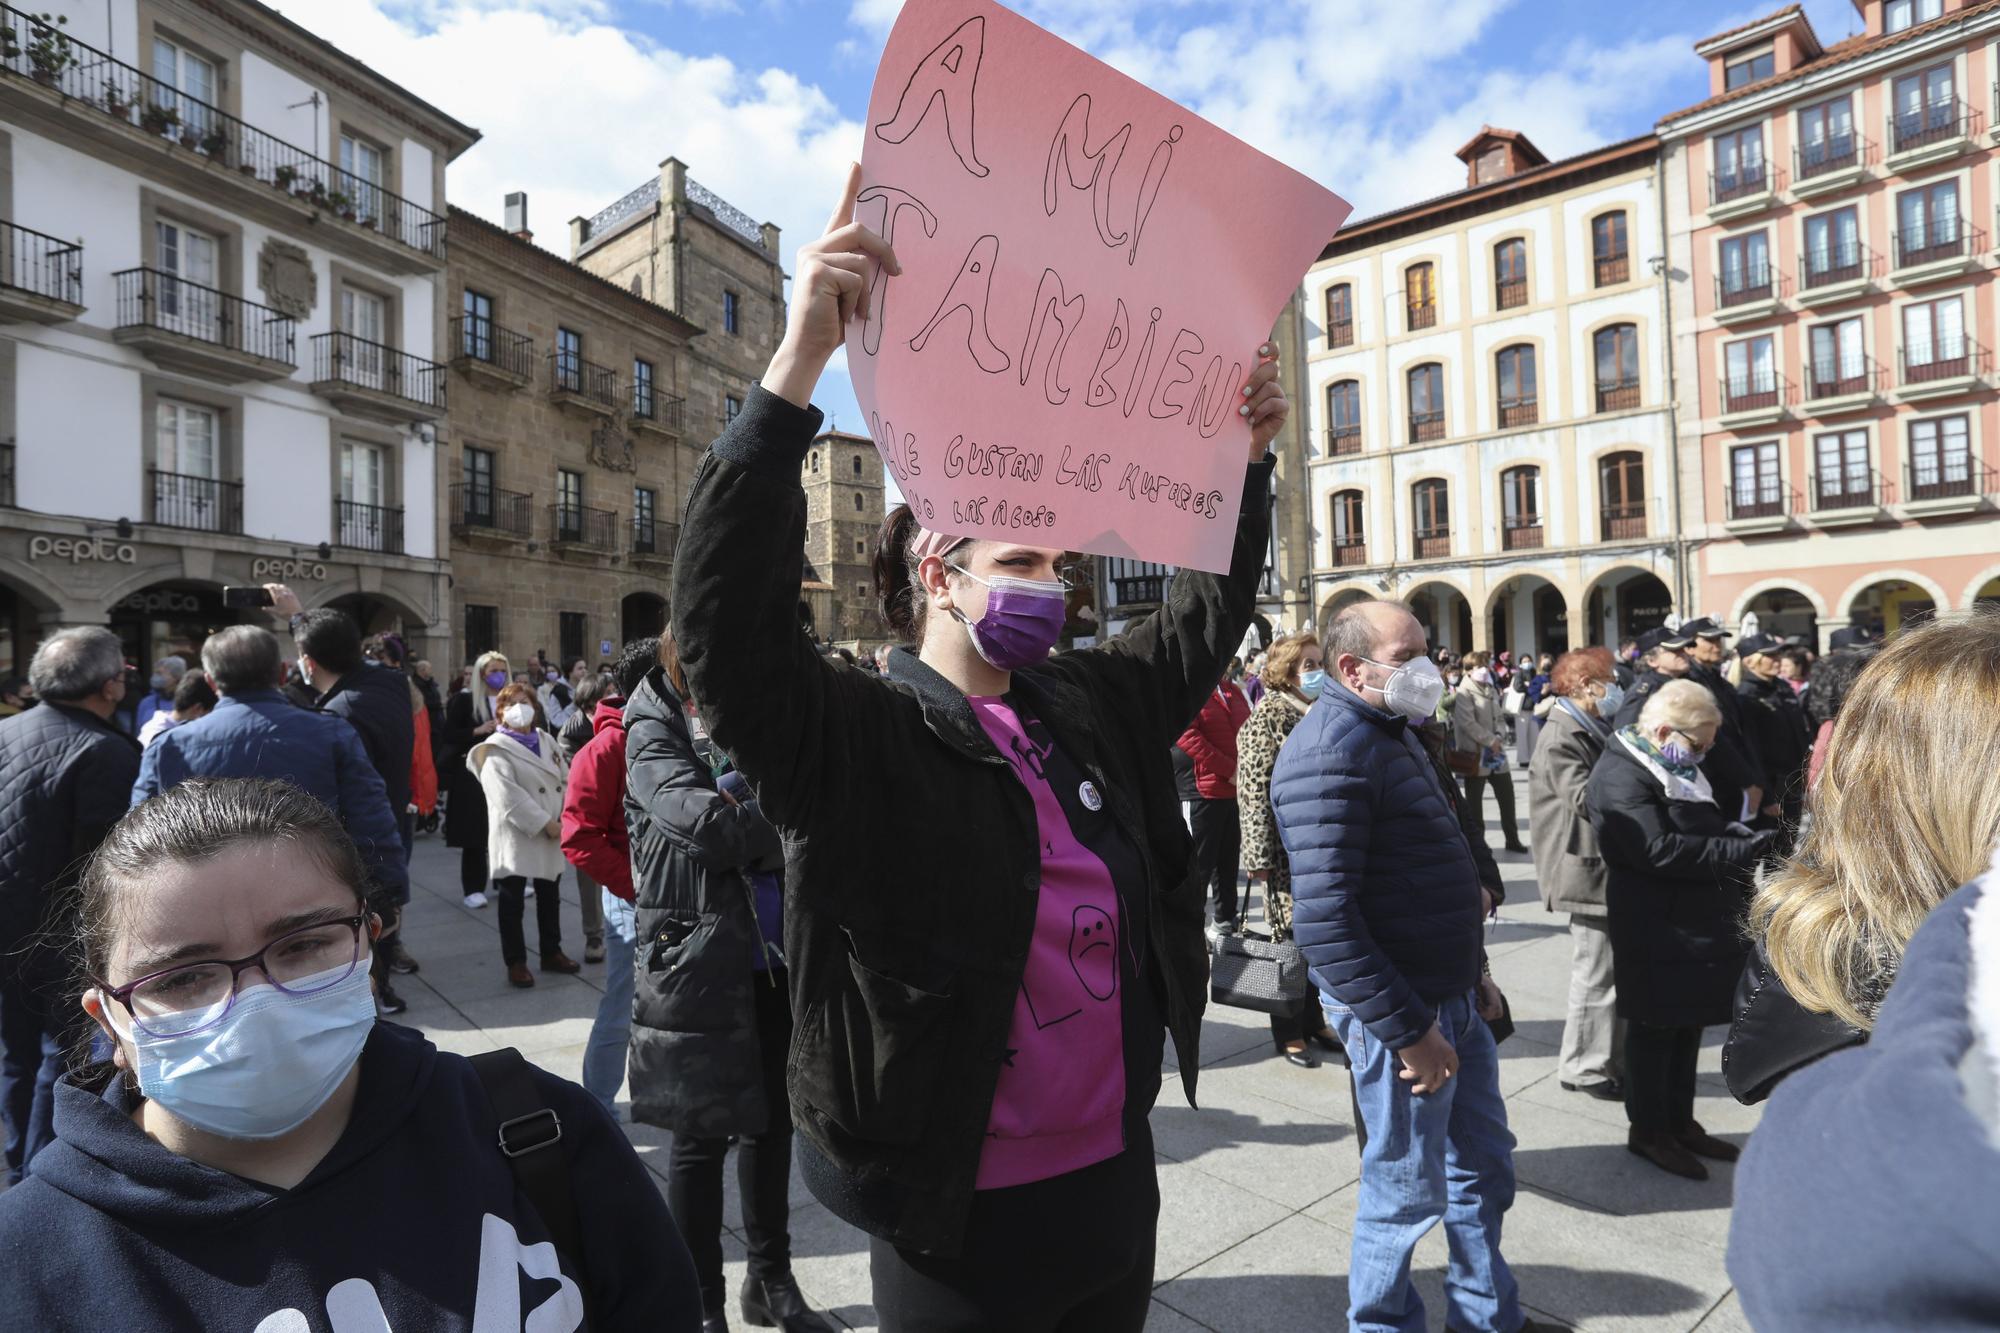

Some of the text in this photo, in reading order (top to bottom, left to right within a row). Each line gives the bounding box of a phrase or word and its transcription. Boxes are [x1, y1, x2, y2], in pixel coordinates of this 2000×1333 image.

[874, 15, 990, 178] A
[872, 410, 921, 481] ME
[943, 434, 1043, 482] GUSTAN
[1055, 444, 1111, 493] LAS
[953, 495, 989, 526] LAS
[991, 499, 1057, 529] ACOSO
[30, 534, 137, 563] pepita
[252, 558, 327, 581] pepita
